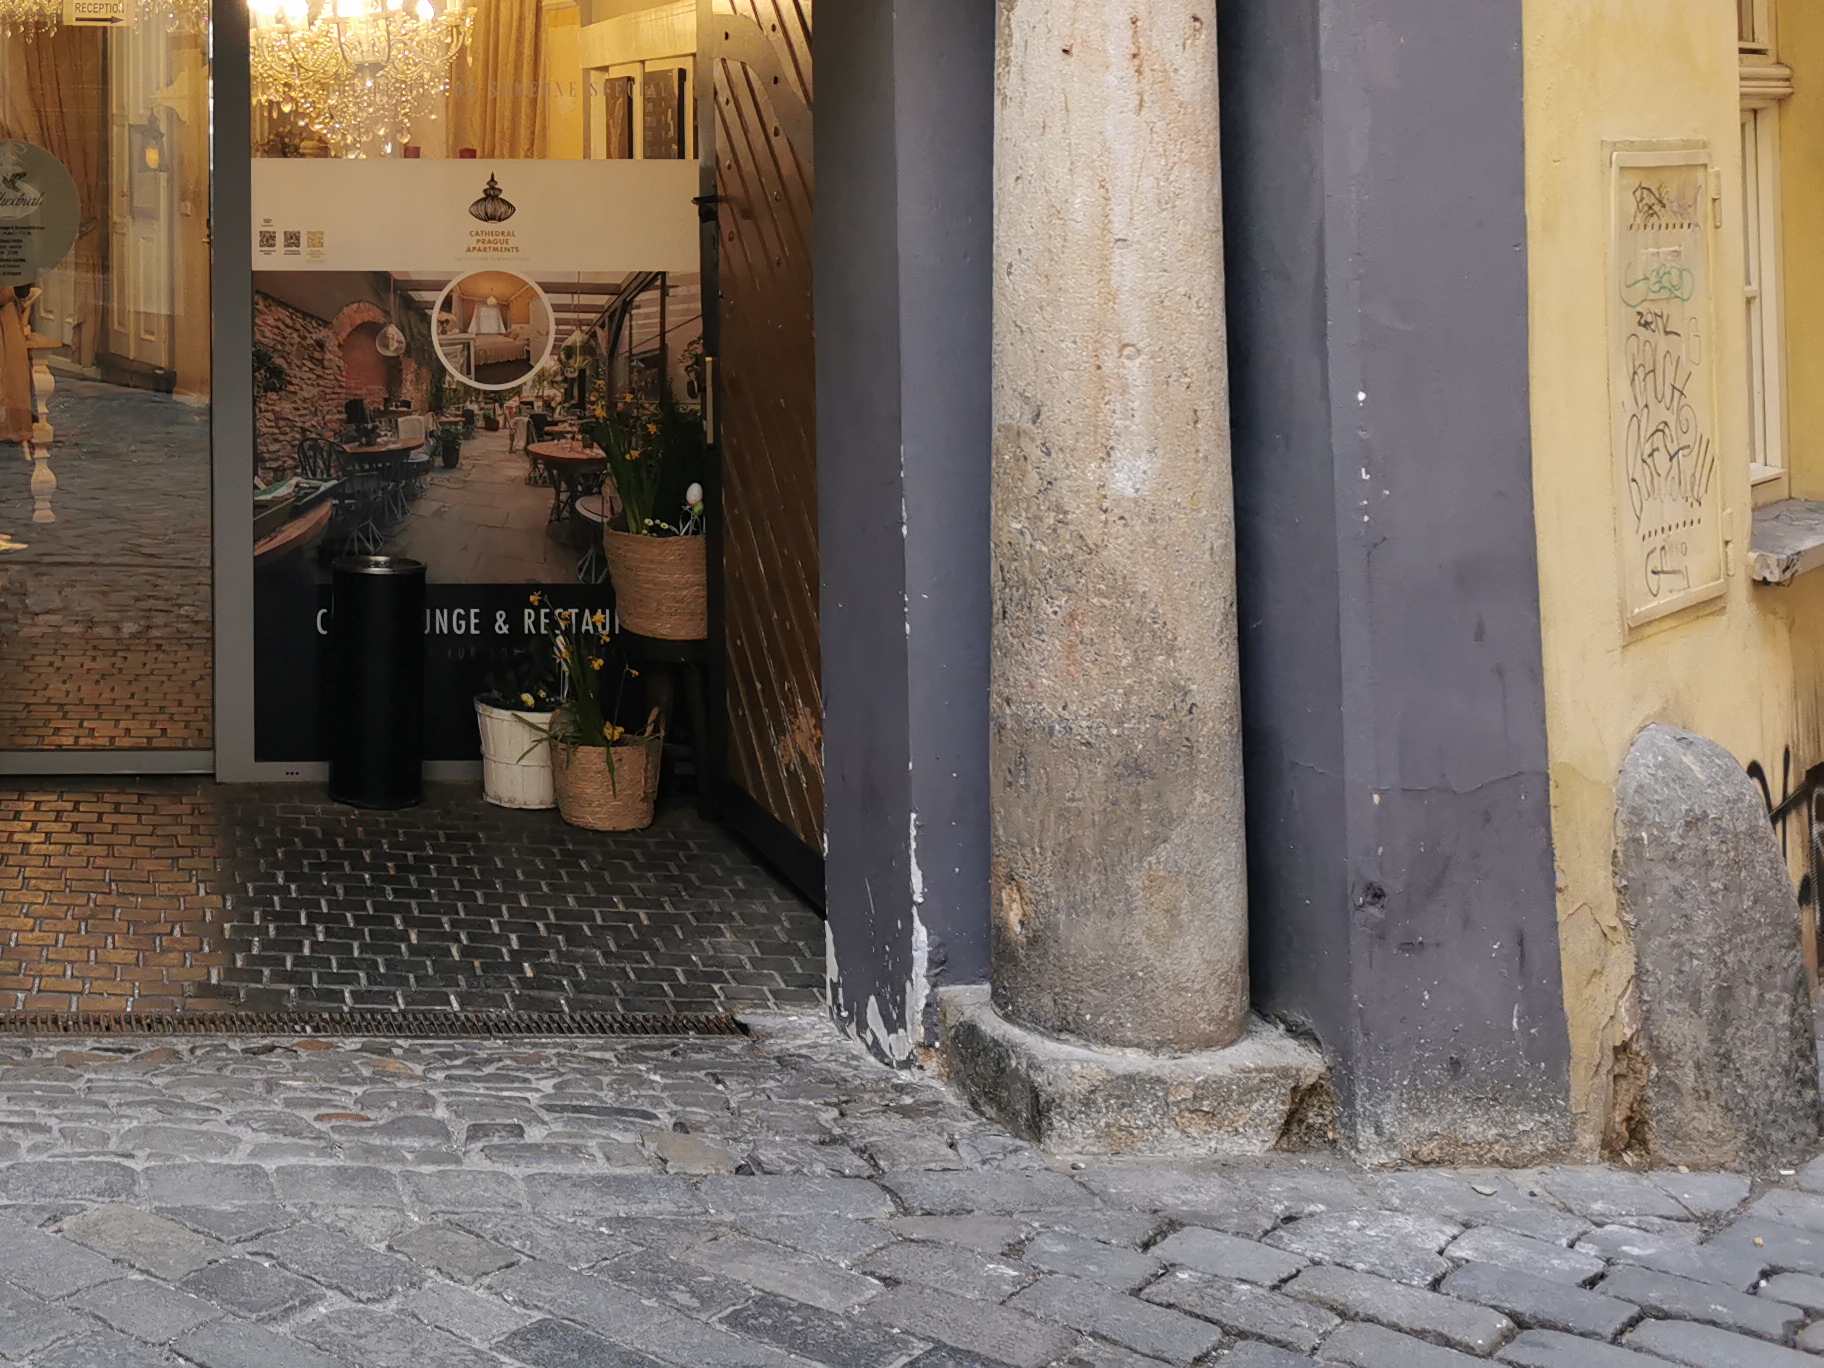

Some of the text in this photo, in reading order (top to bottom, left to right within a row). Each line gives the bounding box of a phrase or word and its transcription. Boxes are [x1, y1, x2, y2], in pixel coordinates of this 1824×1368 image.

[469, 230, 517, 238] CATHEDRAL
[424, 608, 481, 634] UNGE
[494, 609, 510, 635] &
